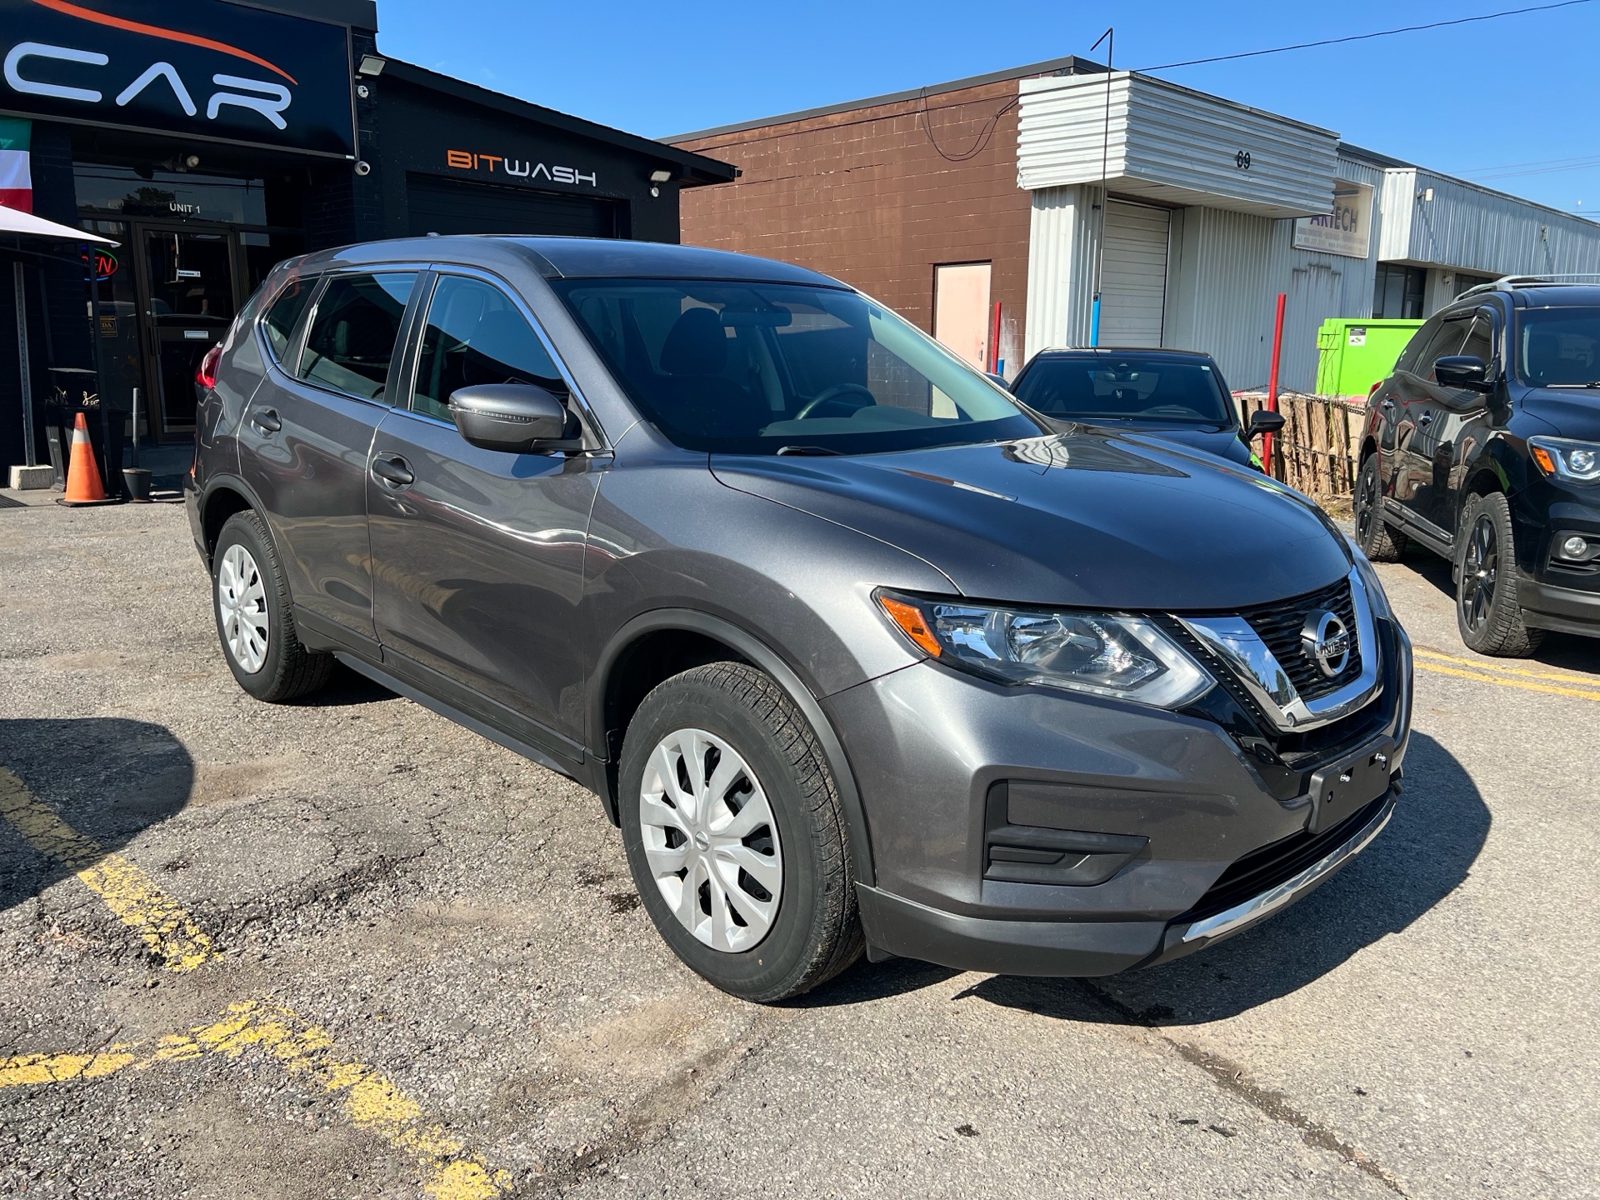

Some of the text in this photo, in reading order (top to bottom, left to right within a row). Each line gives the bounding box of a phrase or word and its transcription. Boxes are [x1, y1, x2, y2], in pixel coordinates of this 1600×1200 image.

[4, 41, 292, 130] CAR
[447, 149, 597, 187] BITWASH
[1237, 150, 1250, 169] 69
[169, 202, 201, 213] UNIT 1
